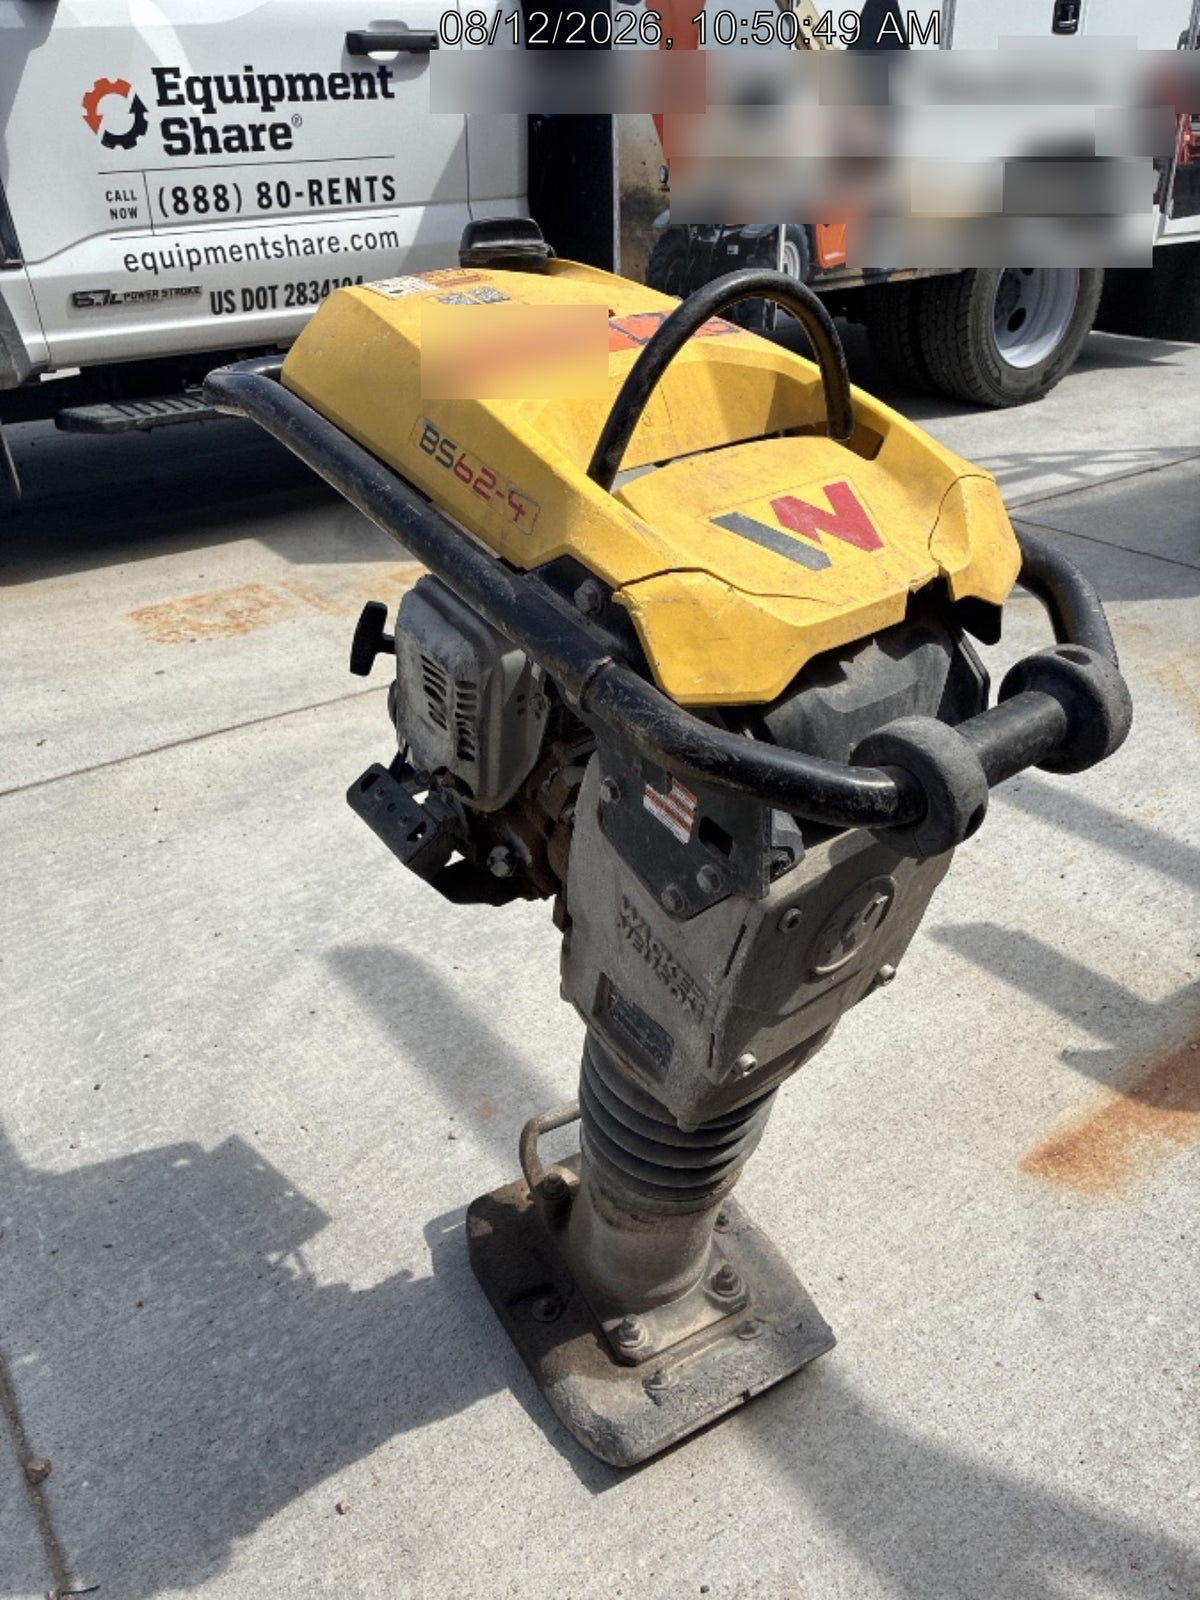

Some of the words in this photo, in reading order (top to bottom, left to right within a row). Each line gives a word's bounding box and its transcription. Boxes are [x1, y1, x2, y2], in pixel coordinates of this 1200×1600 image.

[151, 65, 395, 114] Equipment
[105, 189, 138, 203] CALL
[109, 207, 138, 220] NOW
[158, 182, 243, 218] (888)
[256, 175, 396, 209] 80-RENTS
[123, 230, 399, 275] equipmentshare.com
[72, 289, 123, 308] 6.7L
[123, 289, 160, 301] POWER
[161, 285, 202, 298] STROKE
[209, 289, 236, 315] US
[242, 285, 279, 312] DOT
[419, 424, 526, 522] BS62-4
